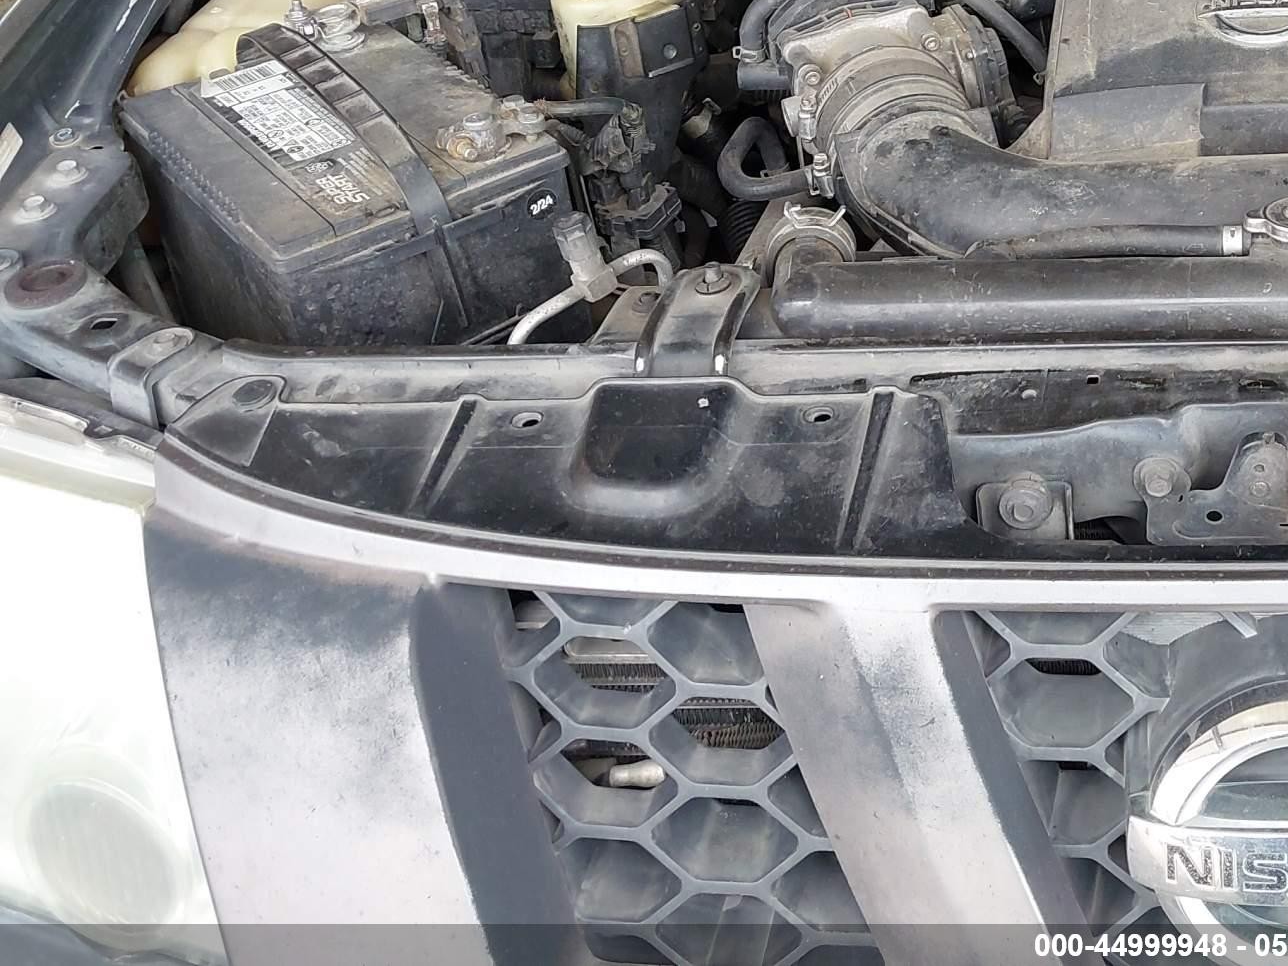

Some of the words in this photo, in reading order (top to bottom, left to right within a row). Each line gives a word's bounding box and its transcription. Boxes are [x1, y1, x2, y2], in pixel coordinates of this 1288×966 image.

[316, 177, 350, 205] SUPER
[331, 173, 370, 203] START
[530, 194, 554, 215] 2/24
